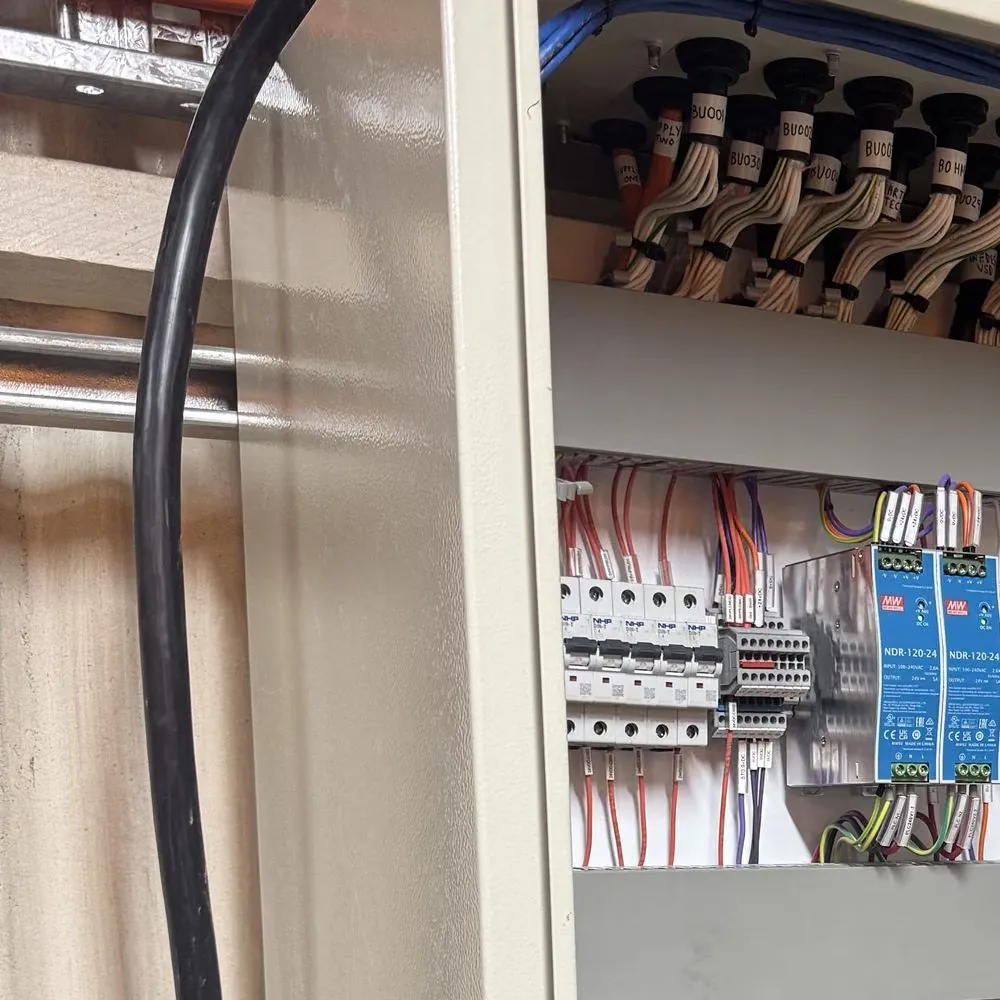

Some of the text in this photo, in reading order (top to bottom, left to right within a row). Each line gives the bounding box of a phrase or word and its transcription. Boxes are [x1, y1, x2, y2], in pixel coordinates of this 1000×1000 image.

[592, 617, 612, 625] NHP
[657, 622, 676, 630] NHP
[884, 647, 938, 658] NDR-120-24
[949, 651, 1000, 661] NDR-120-24
[883, 729, 897, 740] CE
[948, 731, 960, 742] CE
